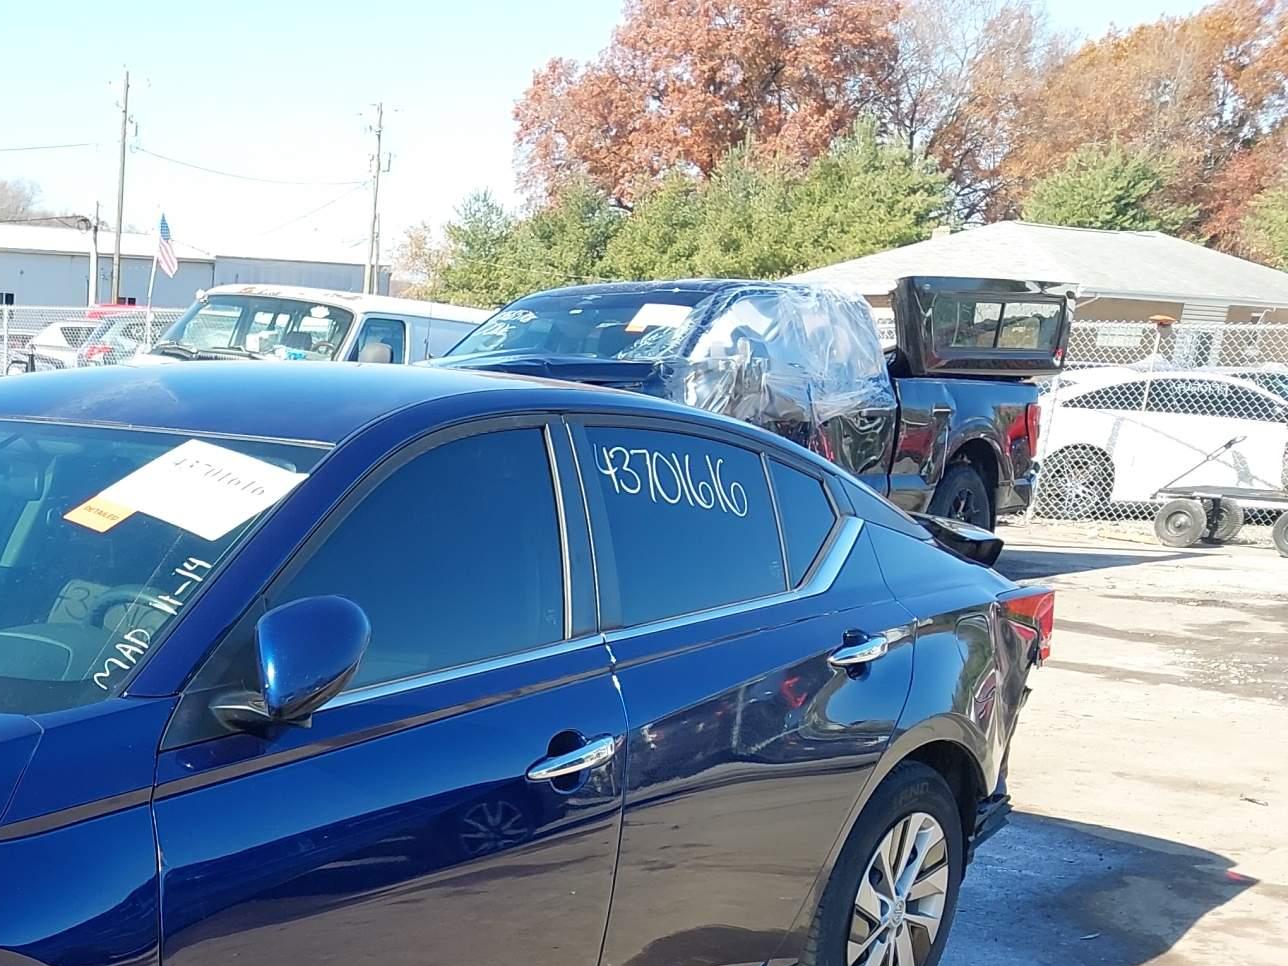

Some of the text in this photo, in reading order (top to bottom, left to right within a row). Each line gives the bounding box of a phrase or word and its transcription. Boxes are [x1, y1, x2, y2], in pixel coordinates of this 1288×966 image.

[593, 443, 748, 517] 43701616
[93, 628, 151, 690] MAD
[149, 557, 212, 615] 11-14
